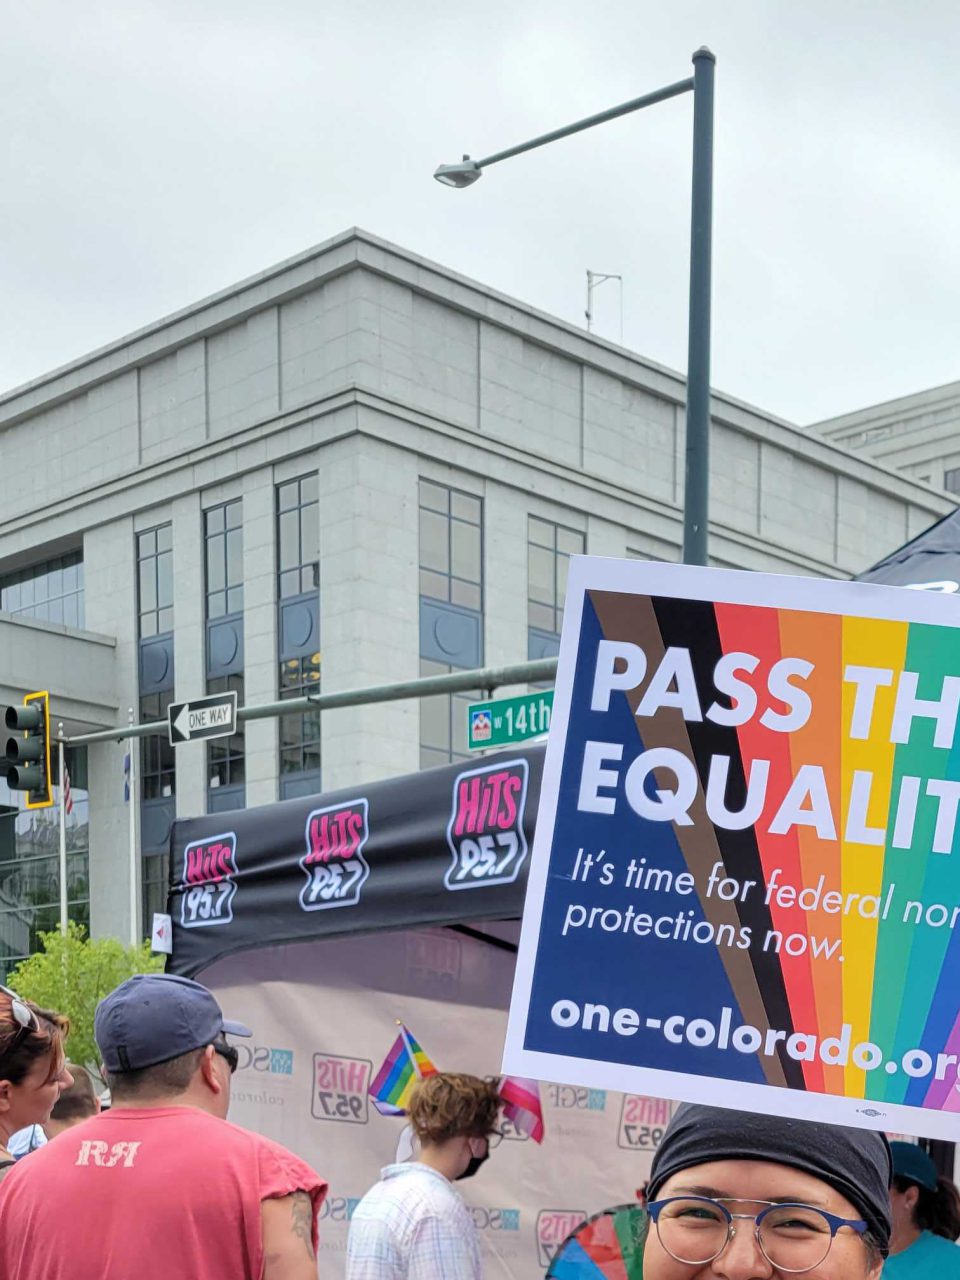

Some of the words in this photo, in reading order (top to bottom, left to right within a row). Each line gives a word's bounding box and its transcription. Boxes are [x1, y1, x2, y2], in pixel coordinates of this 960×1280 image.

[591, 639, 816, 733] PASS
[190, 711, 207, 729] ONE
[210, 706, 229, 724] WAY
[505, 699, 551, 737] 14th
[456, 832, 518, 880] 95.7
[187, 882, 232, 921] 95.7
[309, 860, 363, 902] 95.7
[571, 848, 615, 885] It's
[625, 857, 696, 895] time
[706, 861, 757, 902] for
[764, 868, 895, 920] federal
[562, 903, 752, 950] protections
[762, 928, 846, 962] now.
